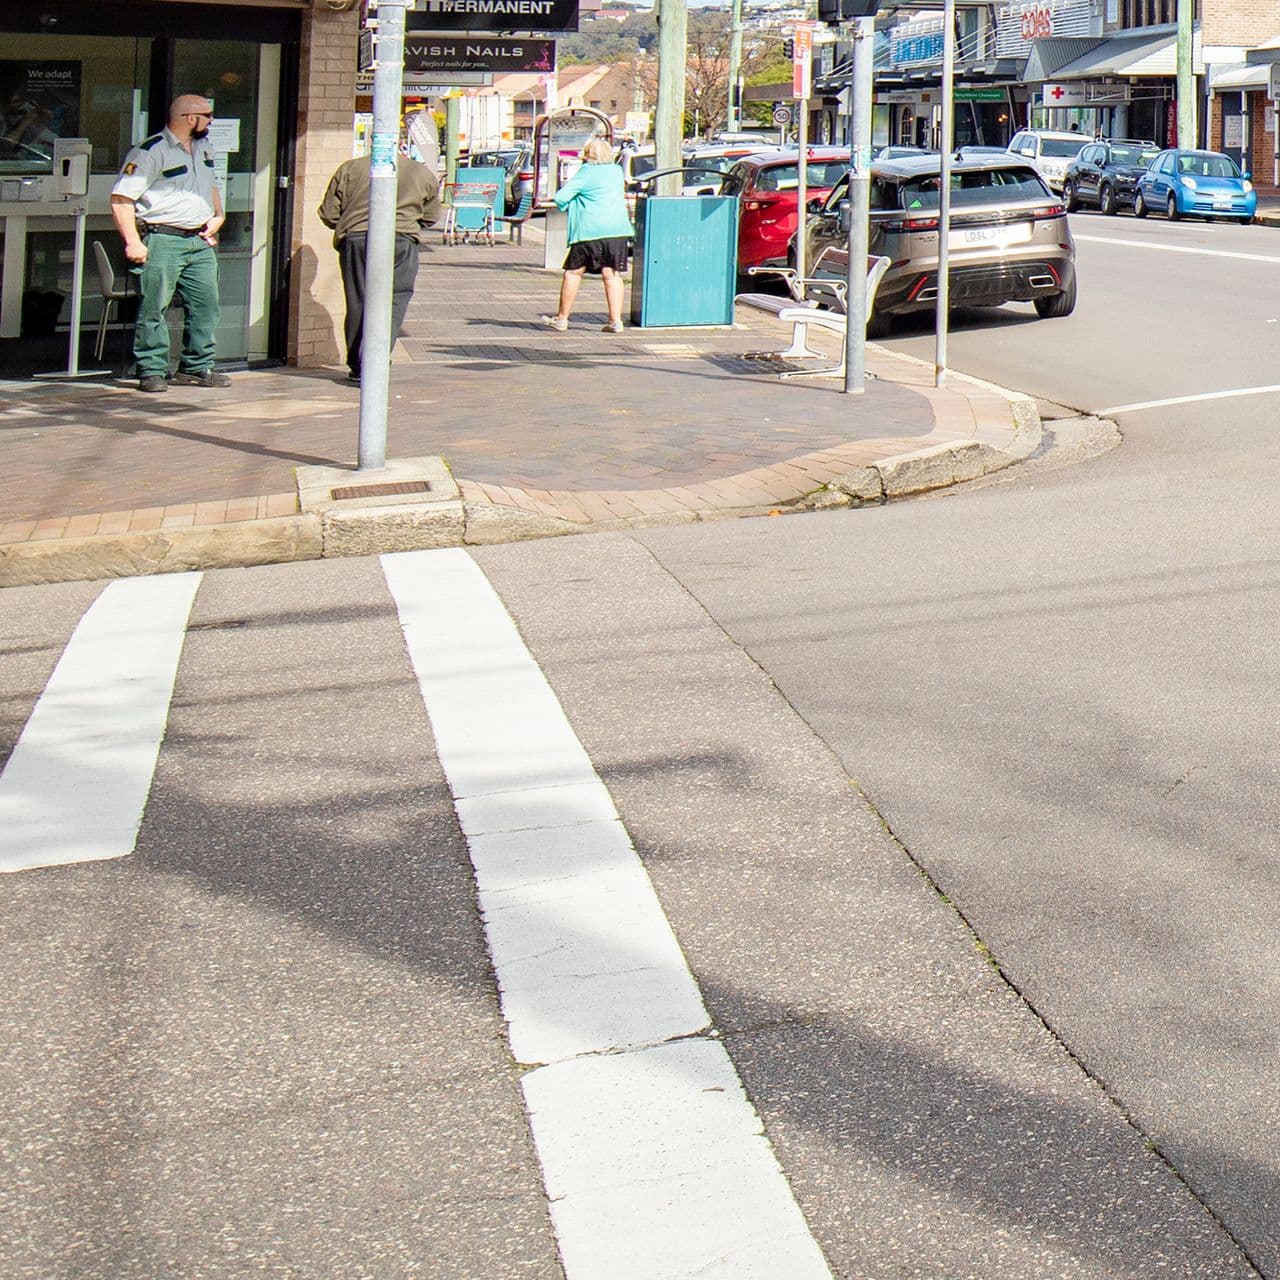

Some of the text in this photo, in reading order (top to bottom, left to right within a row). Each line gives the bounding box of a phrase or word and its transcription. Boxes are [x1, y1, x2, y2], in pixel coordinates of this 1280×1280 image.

[443, 0, 555, 15] PERMANENT
[403, 46, 456, 57] AVISH
[420, 61, 444, 69] Perfect
[27, 69, 73, 79] We adapt
